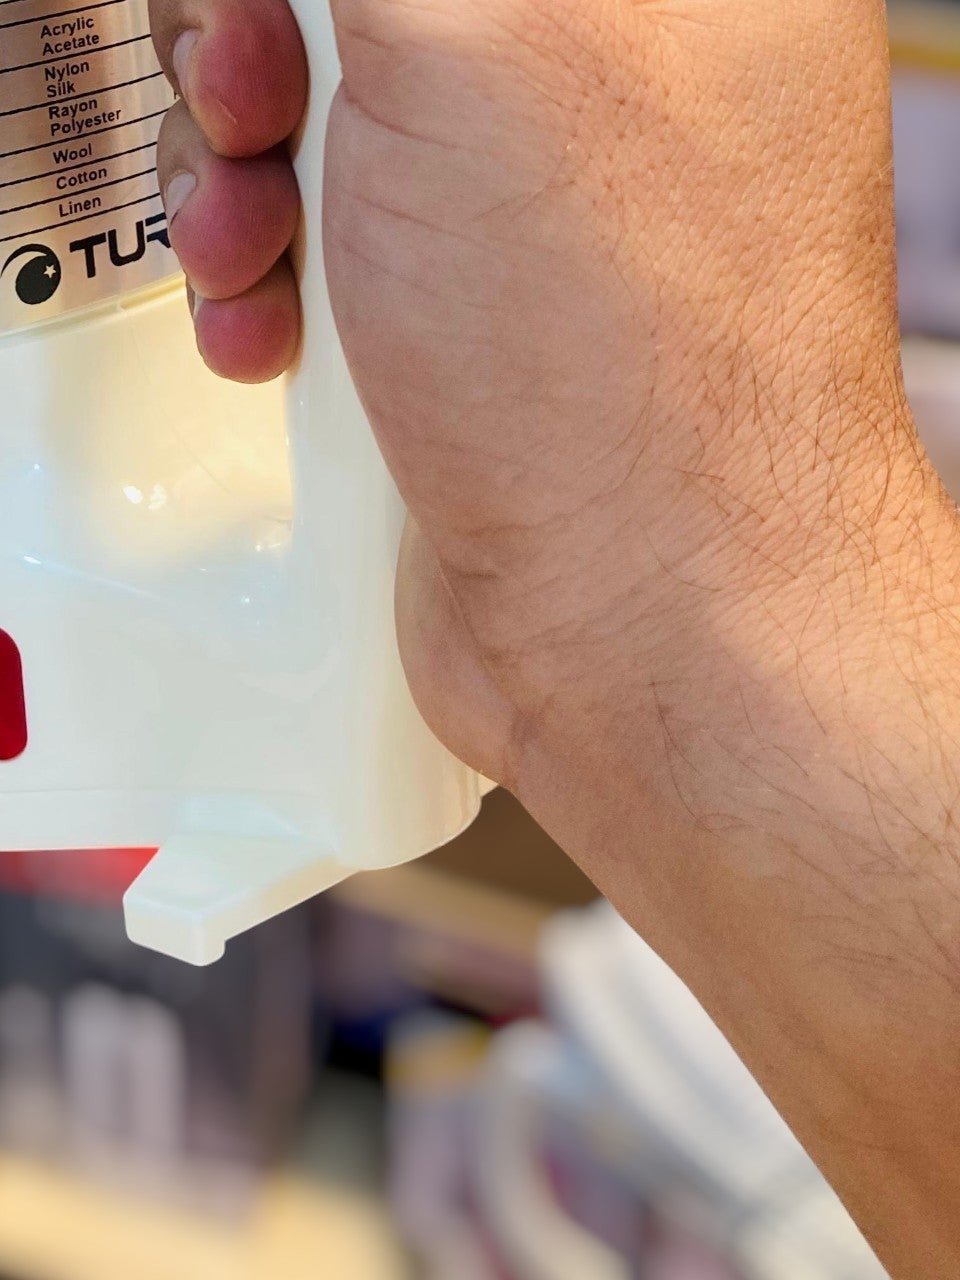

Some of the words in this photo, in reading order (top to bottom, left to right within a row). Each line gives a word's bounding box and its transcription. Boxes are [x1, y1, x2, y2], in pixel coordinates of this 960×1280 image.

[40, 17, 95, 39] Acrylic
[42, 33, 100, 56] Acetate
[44, 60, 90, 81] Nylon
[46, 81, 76, 98] Silk
[48, 98, 98, 120] Rayon
[50, 108, 122, 136] Polyester
[53, 144, 93, 164] Wool
[56, 167, 108, 190] Cotton
[58, 197, 101, 218] Linen
